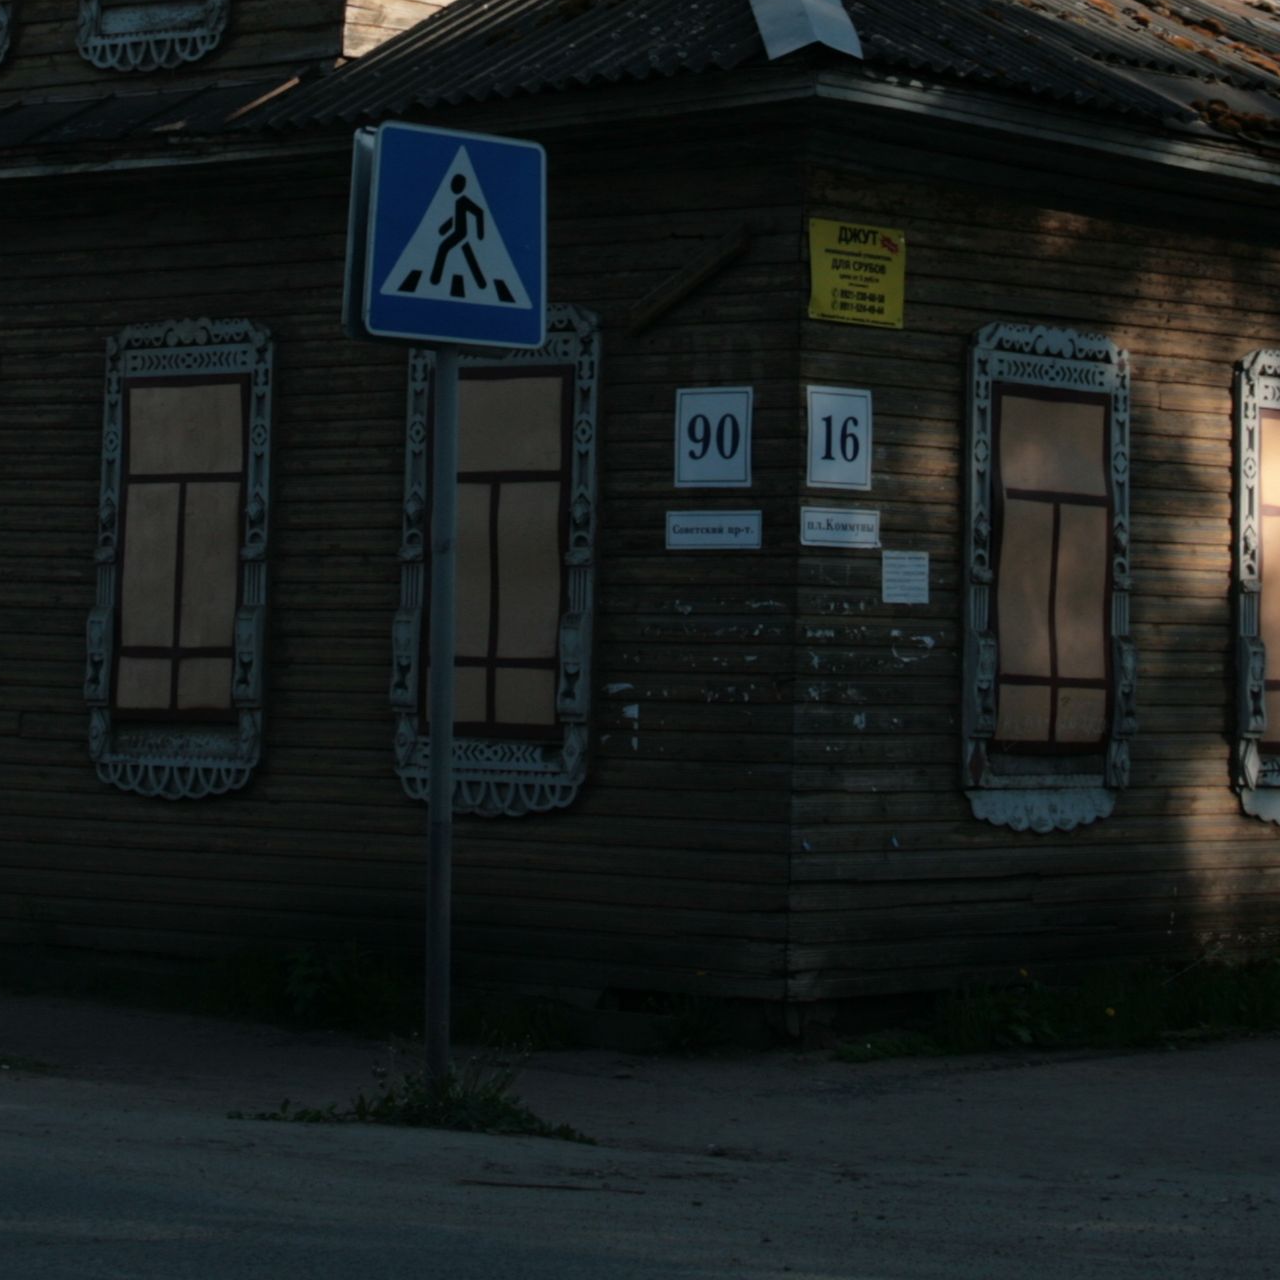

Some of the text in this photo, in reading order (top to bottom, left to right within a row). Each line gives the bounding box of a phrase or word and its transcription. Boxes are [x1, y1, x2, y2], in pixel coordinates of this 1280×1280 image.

[838, 225, 879, 246] ДЖУТ
[687, 412, 740, 460] 90
[820, 414, 860, 462] 16
[672, 523, 724, 535] Советский
